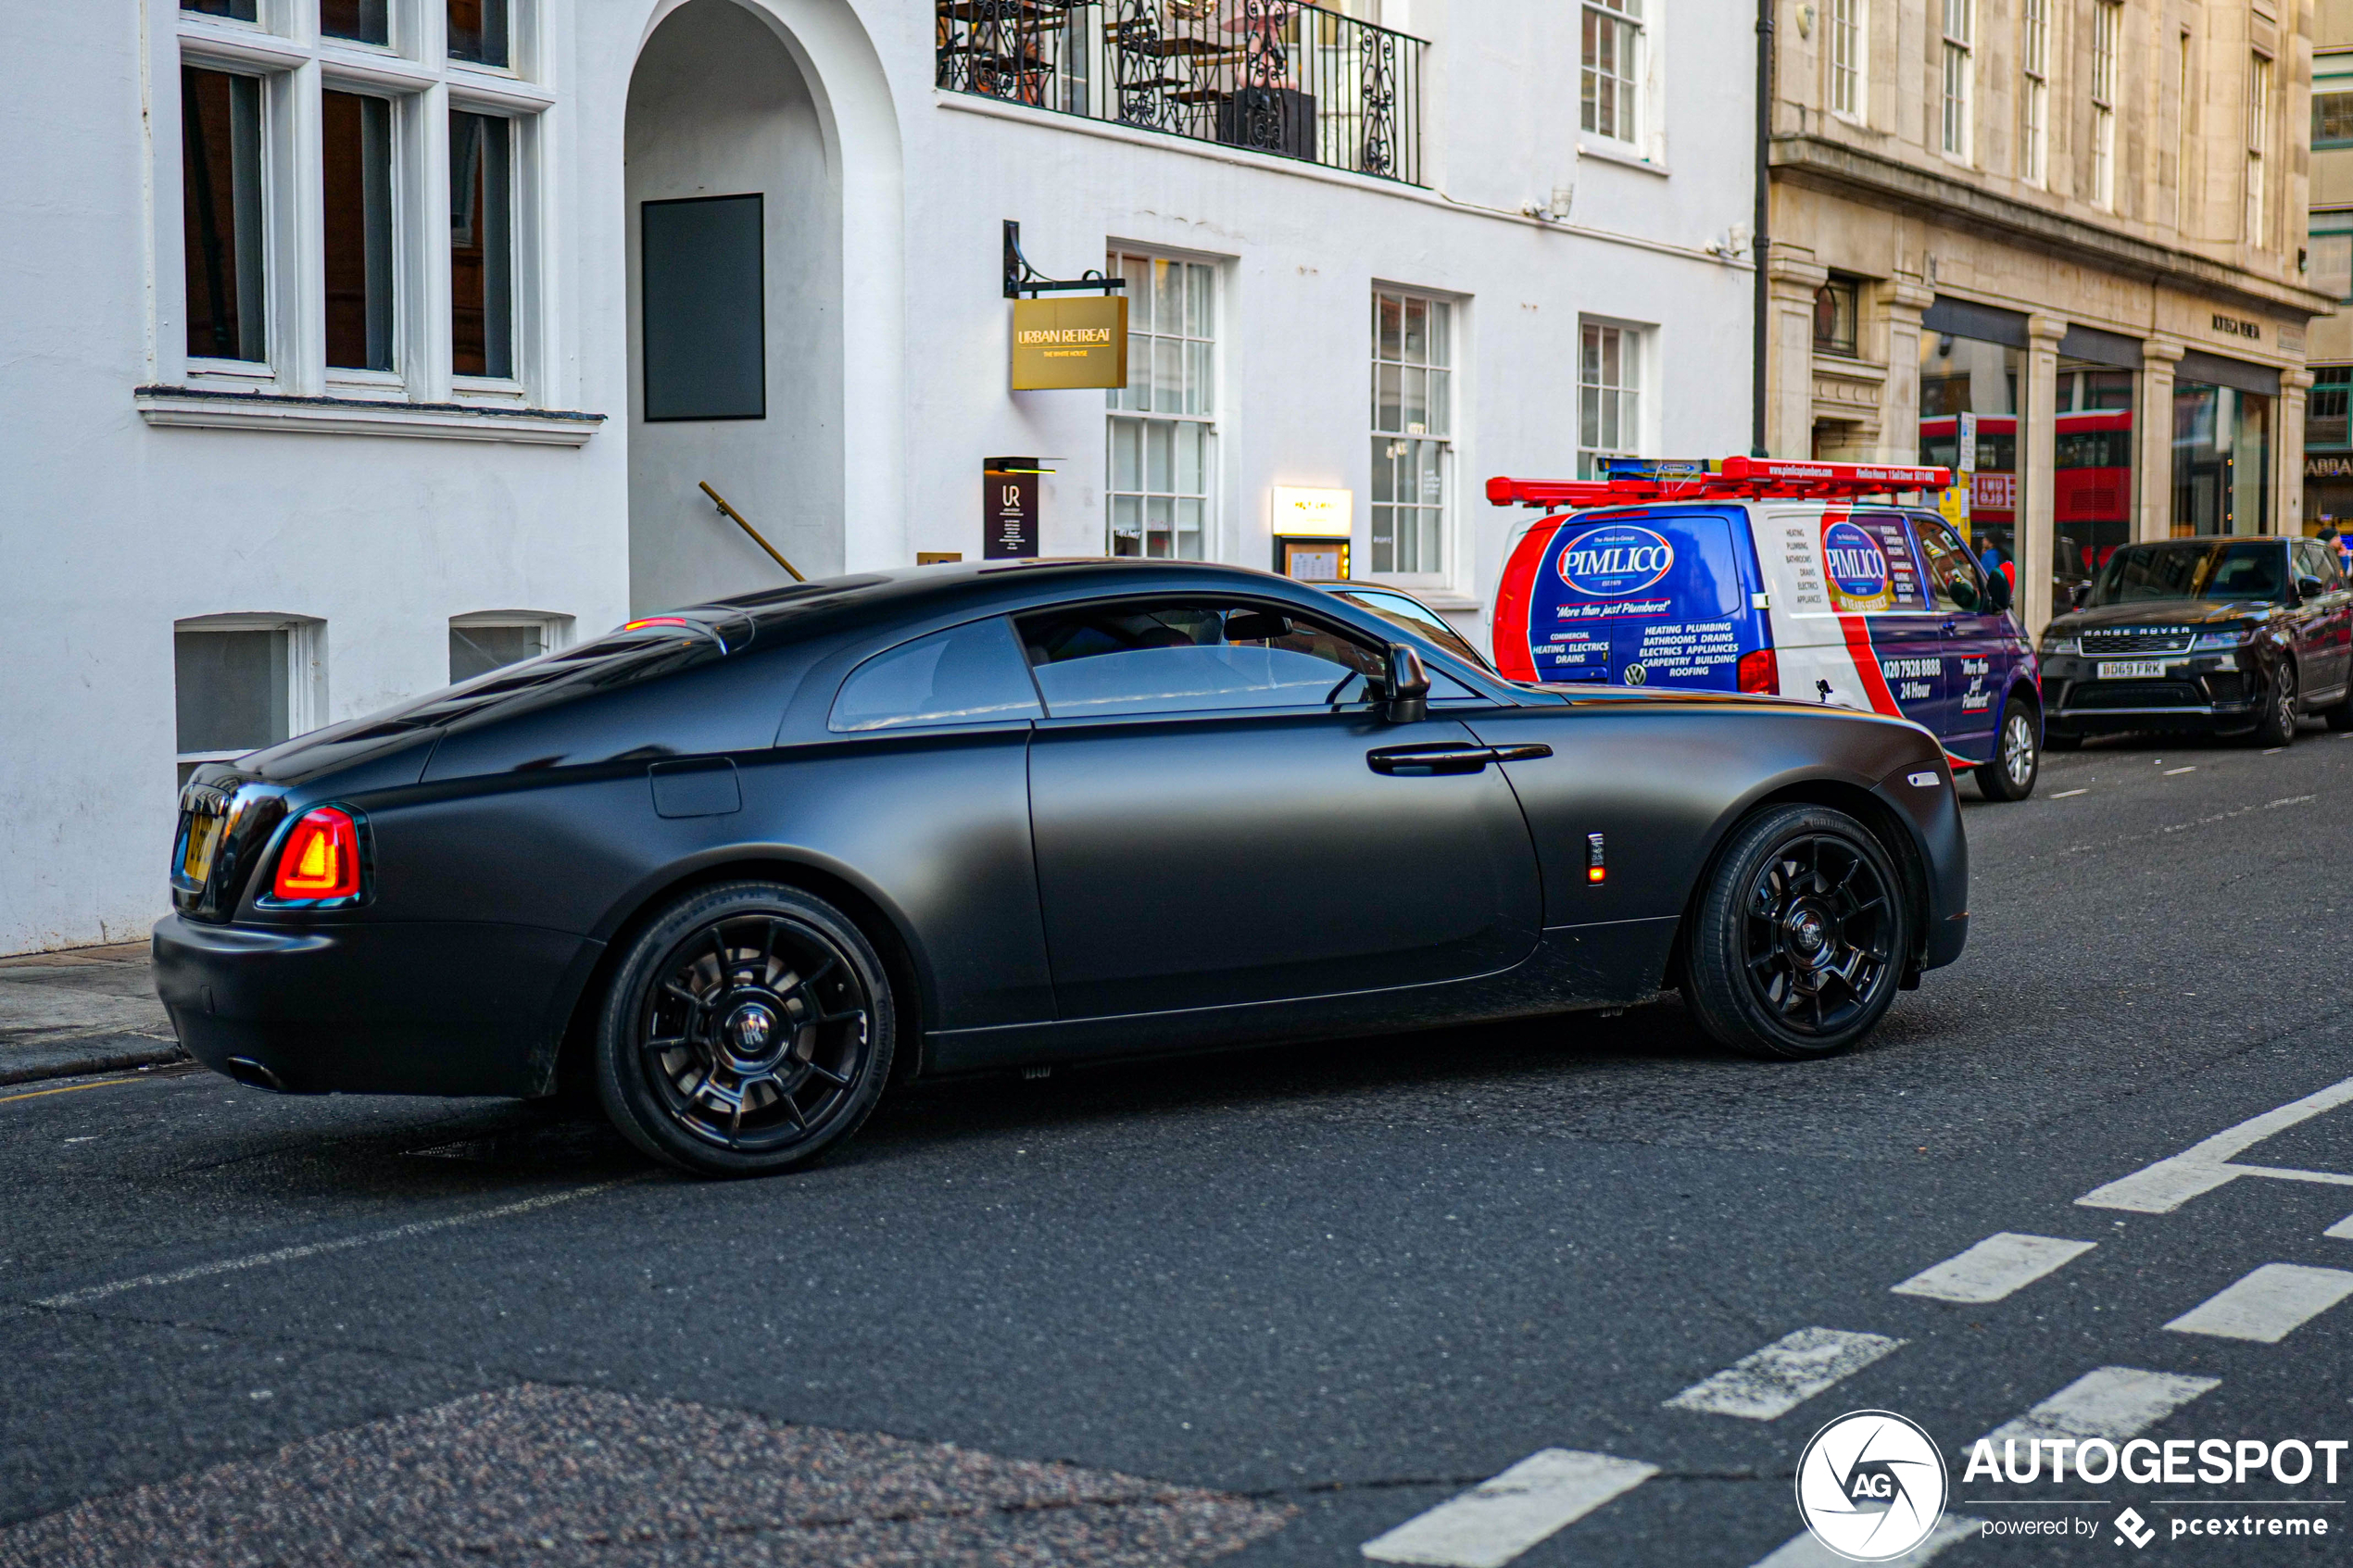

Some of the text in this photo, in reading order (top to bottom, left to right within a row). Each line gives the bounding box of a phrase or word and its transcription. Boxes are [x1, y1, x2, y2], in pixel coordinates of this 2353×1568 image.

[1018, 328, 1111, 344] URBAN RETREAT
[1002, 484, 1020, 507] UR
[1562, 546, 1672, 576] PIMLICO
[1825, 548, 1886, 579] PIMLICO
[1581, 604, 1601, 616] than
[1600, 602, 1622, 617] just
[1644, 622, 1731, 635] HEATING PLUMBING
[2083, 626, 2190, 637] RANGE ROVER
[1550, 632, 1591, 640] COMMERCIAL
[1643, 633, 1733, 646] BATHROOMS DRAINS
[1533, 642, 1609, 654] HEATING ELECTRICS
[1639, 644, 1739, 657] ELECTRICS APPLIANCES
[1555, 654, 1585, 664] DRAINS
[1642, 655, 1737, 667] CARPENTRY BUILDING
[1669, 666, 1709, 677] ROOFING
[1883, 658, 1941, 679] 020 7928 8888
[2103, 662, 2160, 675] BD69 FRK
[1900, 681, 1931, 699] 24 Hour
